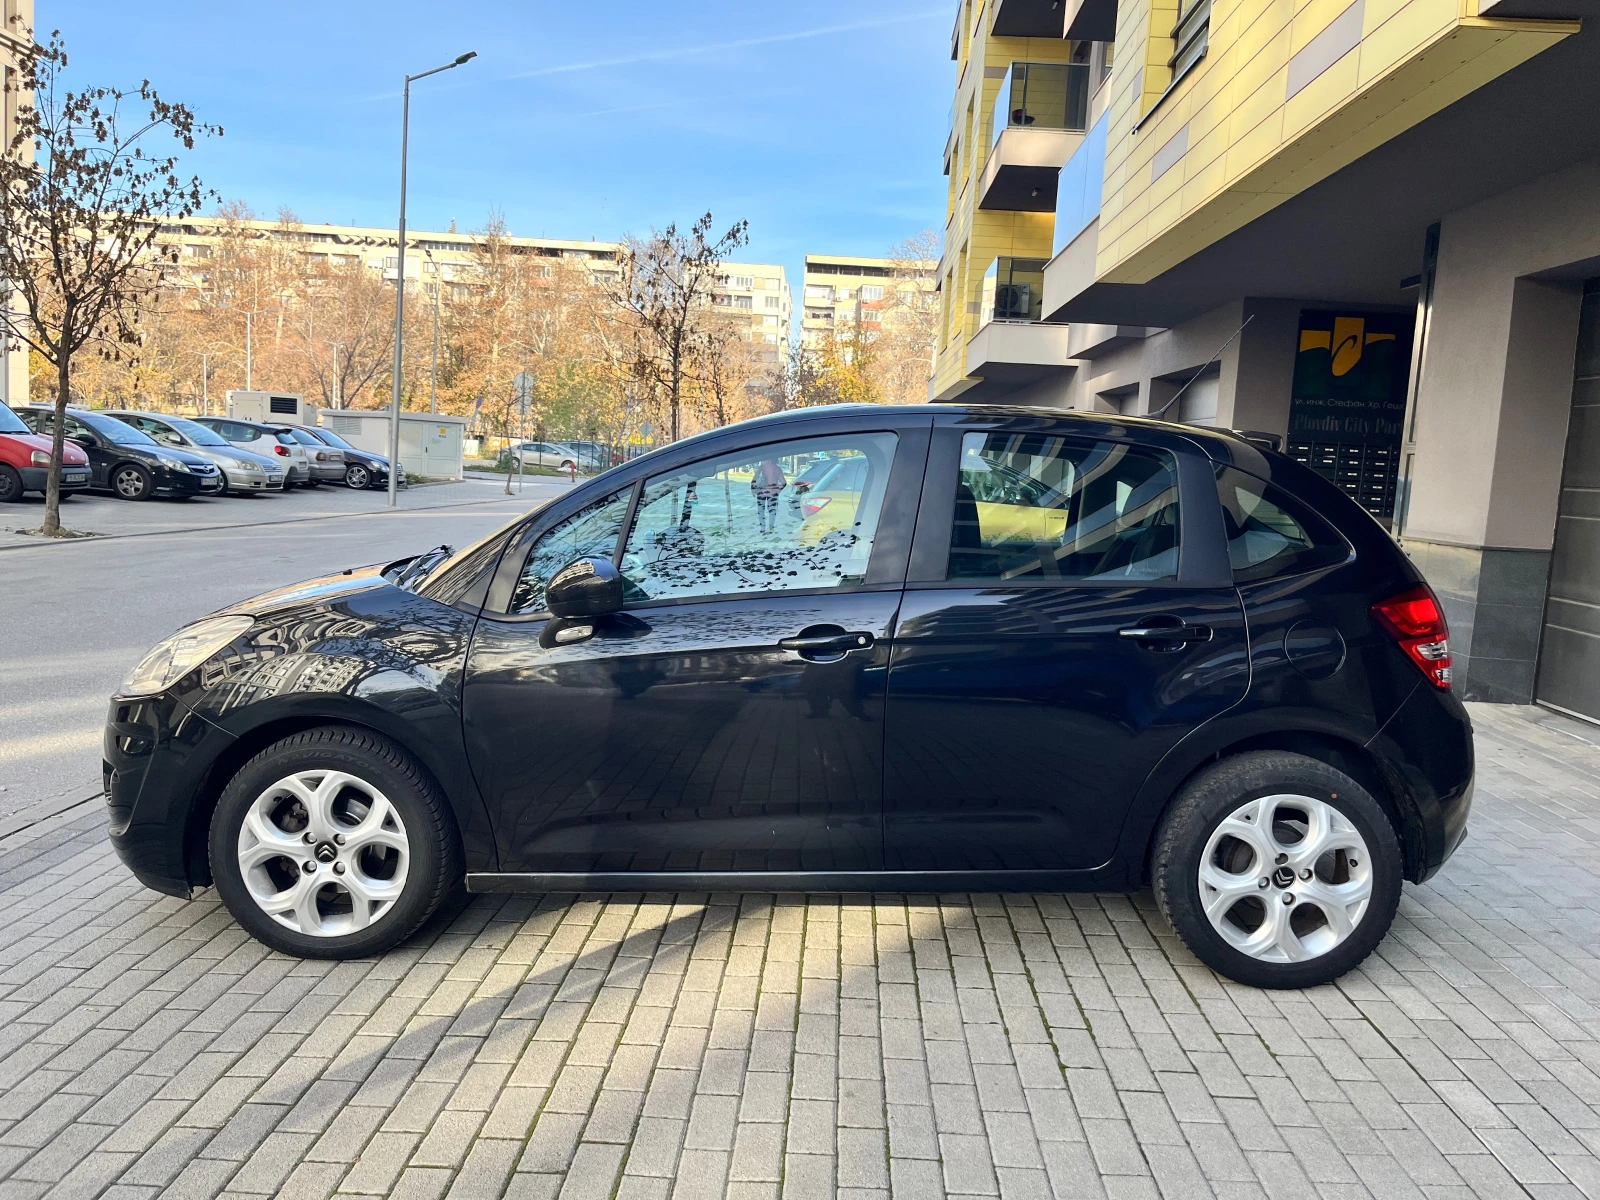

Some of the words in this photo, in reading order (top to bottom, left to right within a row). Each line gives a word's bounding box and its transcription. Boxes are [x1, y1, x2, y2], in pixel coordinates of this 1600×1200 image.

[1327, 398, 1365, 408] Стефан
[1294, 413, 1341, 431] Plovdiv
[1344, 416, 1371, 437] City
